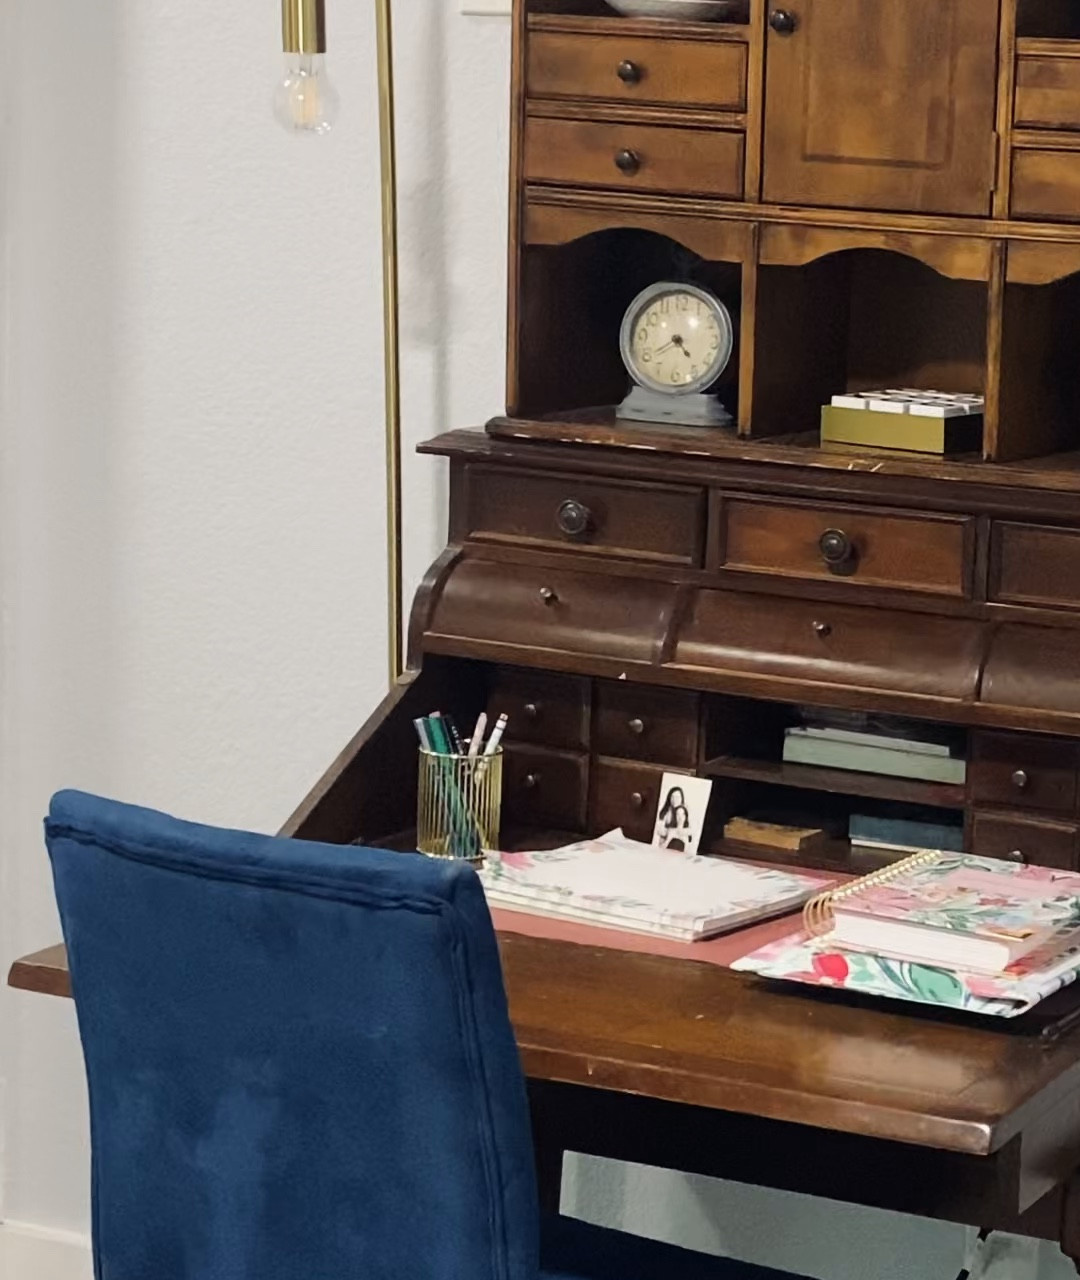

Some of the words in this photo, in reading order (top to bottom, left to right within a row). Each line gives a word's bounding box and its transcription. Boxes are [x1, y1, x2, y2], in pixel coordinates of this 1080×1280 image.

[660, 298, 670, 314] 11
[675, 295, 689, 312] 12
[646, 311, 658, 327] 10
[638, 327, 648, 344] 9
[642, 347, 652, 363] 8
[670, 367, 680, 383] 6
